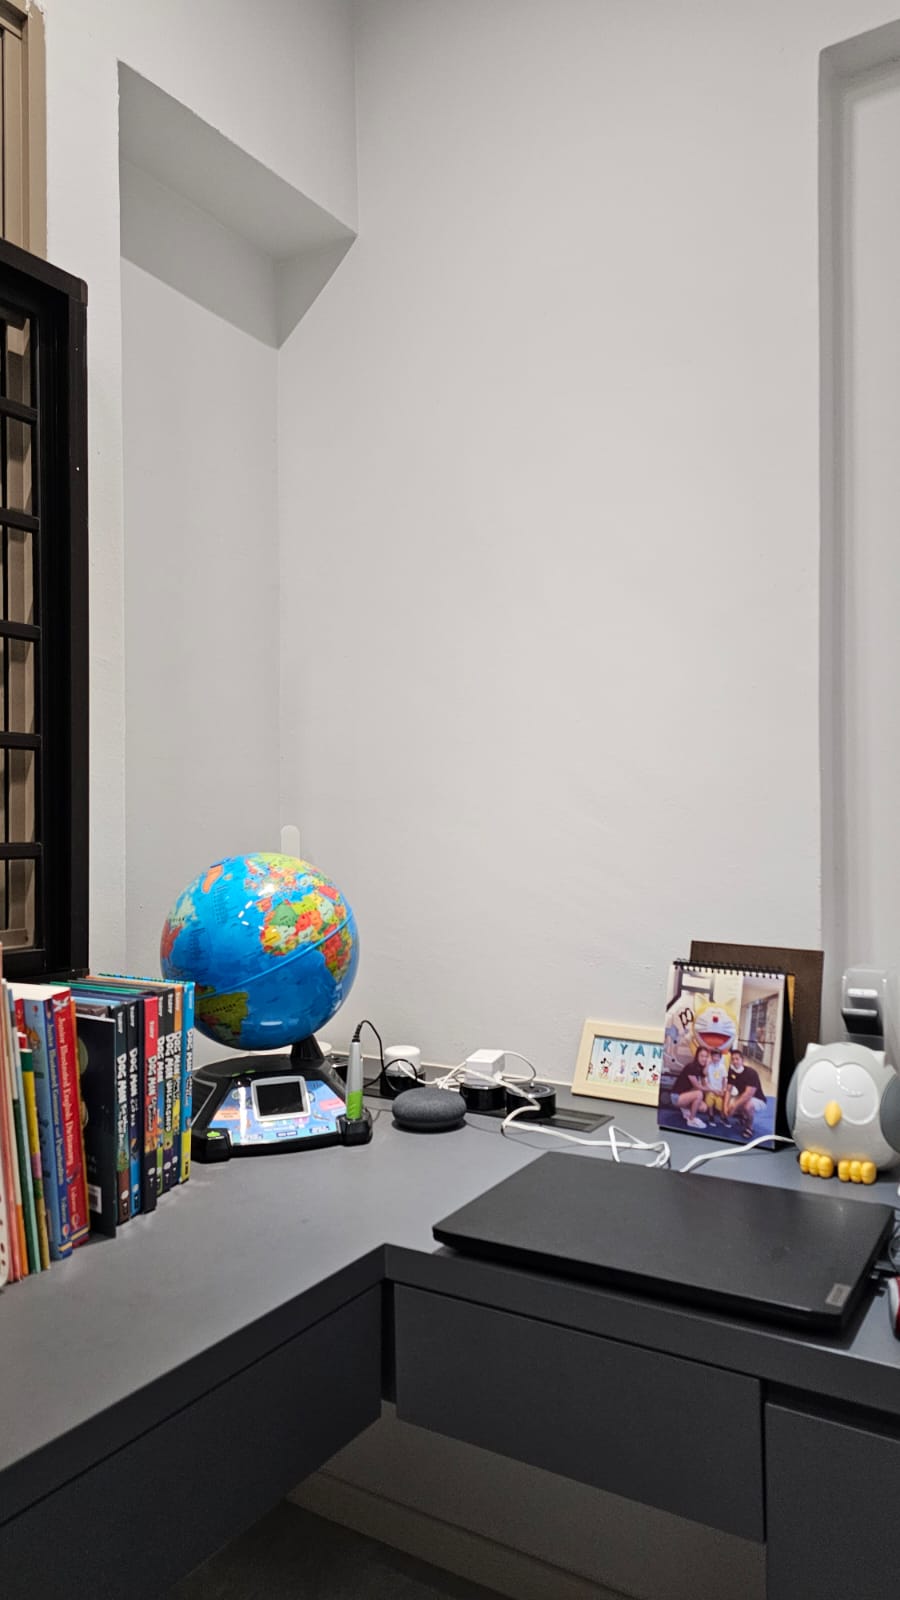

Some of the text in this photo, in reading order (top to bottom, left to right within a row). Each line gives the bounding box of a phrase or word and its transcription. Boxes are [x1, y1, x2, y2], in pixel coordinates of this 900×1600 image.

[166, 1033, 174, 1056] DOG
[117, 1053, 127, 1079] DOG
[129, 1048, 138, 1072] DOG
[148, 1055, 157, 1077] DOG
[165, 1058, 174, 1079] MAN
[118, 1080, 128, 1104] MAN
[130, 1074, 138, 1097] MAN
[148, 1077, 157, 1097] MAN
